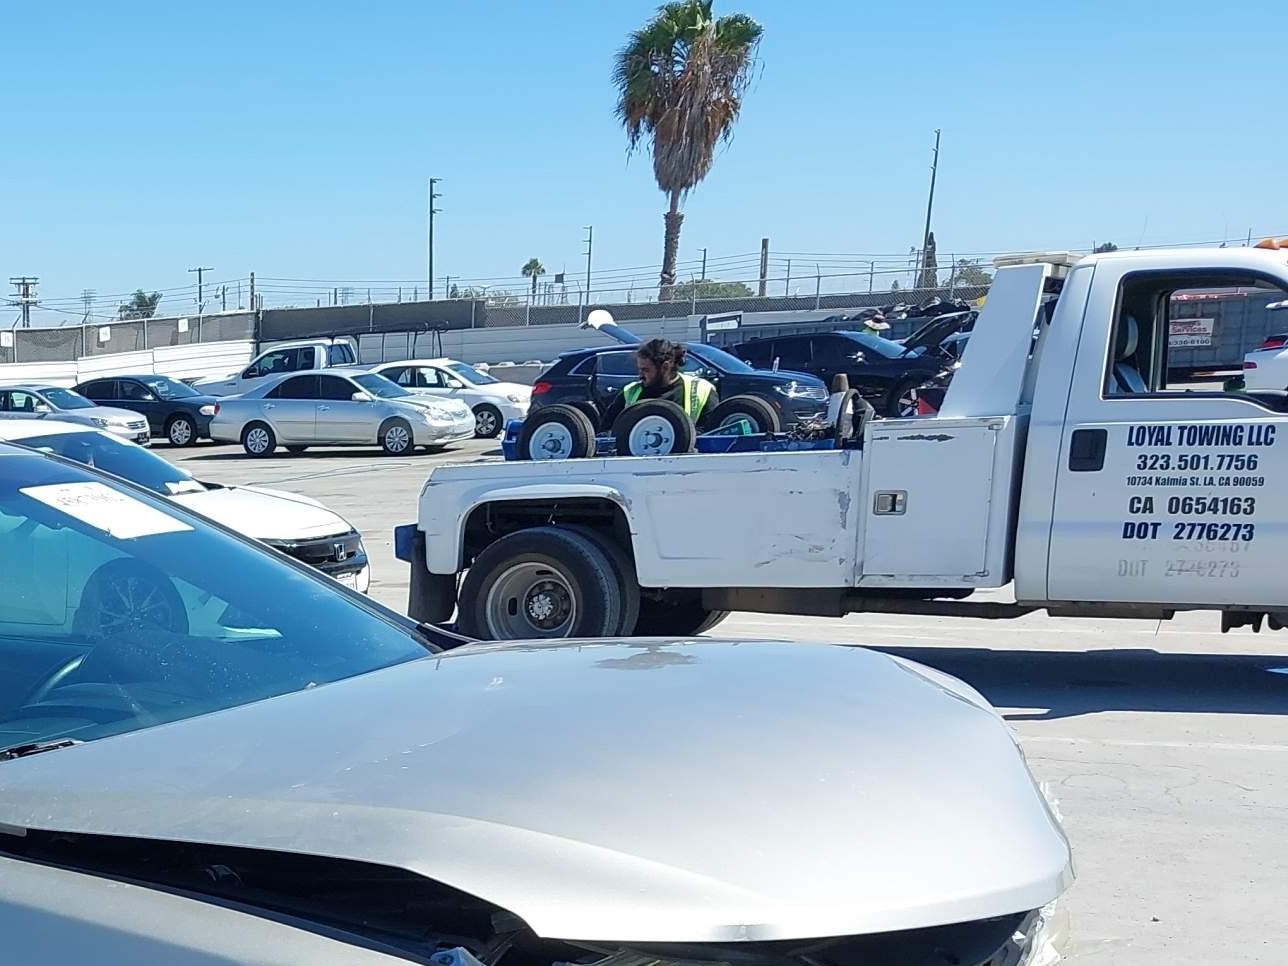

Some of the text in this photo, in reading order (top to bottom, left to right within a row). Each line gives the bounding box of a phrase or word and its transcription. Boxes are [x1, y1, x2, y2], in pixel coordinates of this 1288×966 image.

[1127, 424, 1276, 447] LOYAL TOWING LLC
[1136, 454, 1259, 471] 323.501.7756
[1127, 476, 1152, 486] 10734
[1155, 476, 1187, 486] Kalmia
[1189, 476, 1201, 486] St.
[1218, 476, 1230, 486] CA
[1233, 476, 1265, 486] 90059
[1129, 496, 1256, 516] CA 0654163
[1122, 522, 1255, 541] DOT 2776273
